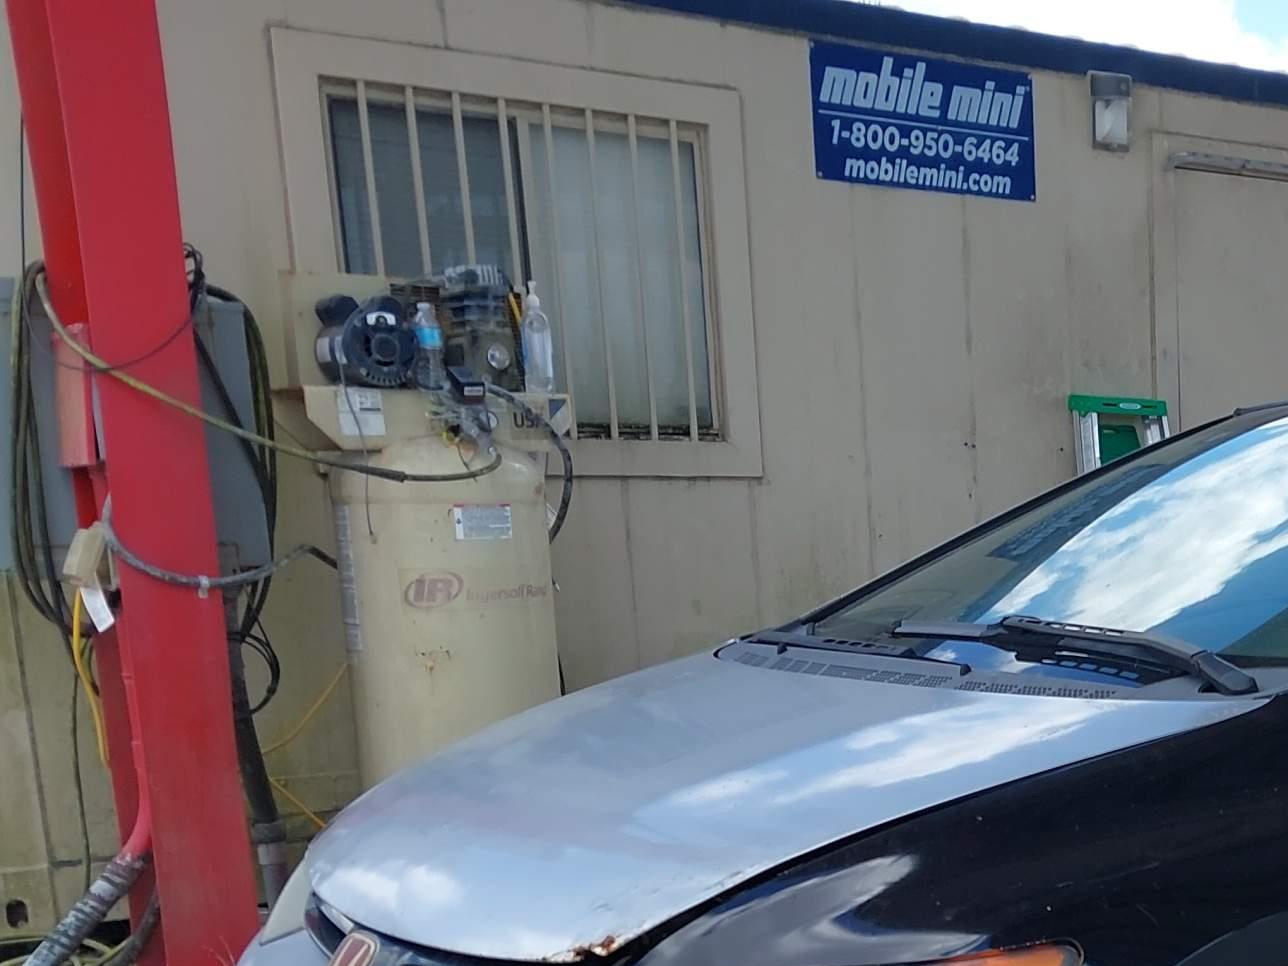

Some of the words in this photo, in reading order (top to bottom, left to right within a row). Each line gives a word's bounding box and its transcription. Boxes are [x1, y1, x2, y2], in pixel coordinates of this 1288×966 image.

[819, 56, 944, 118] mobile
[947, 80, 1025, 129] mini
[831, 119, 1020, 166] 1-800-950-6464
[844, 157, 1012, 195] mobilemini.com
